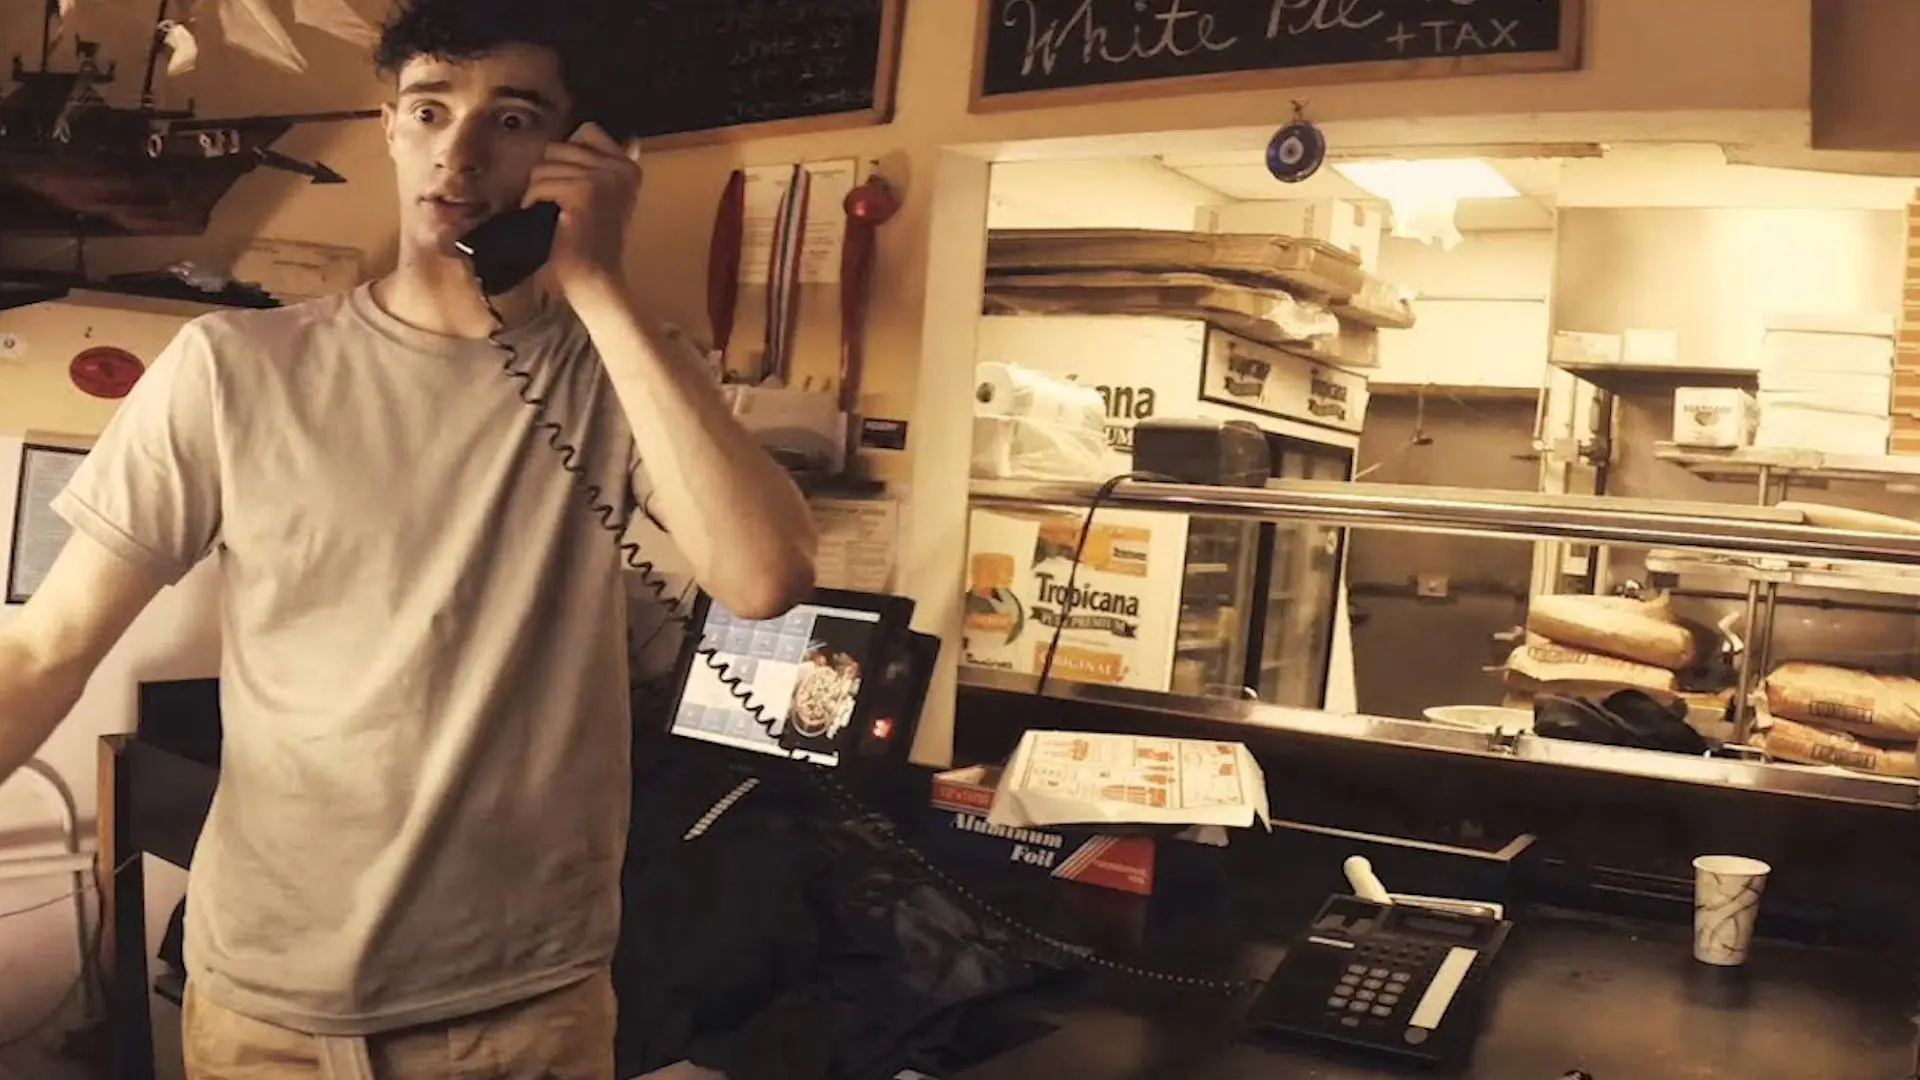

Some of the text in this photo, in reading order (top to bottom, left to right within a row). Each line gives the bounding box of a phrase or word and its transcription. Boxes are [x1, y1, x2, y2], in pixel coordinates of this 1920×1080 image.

[1003, 0, 1238, 77] White
[1034, 571, 1140, 617] Tropicana
[951, 812, 1064, 848] Aluminum
[1010, 842, 1056, 869] Foil
